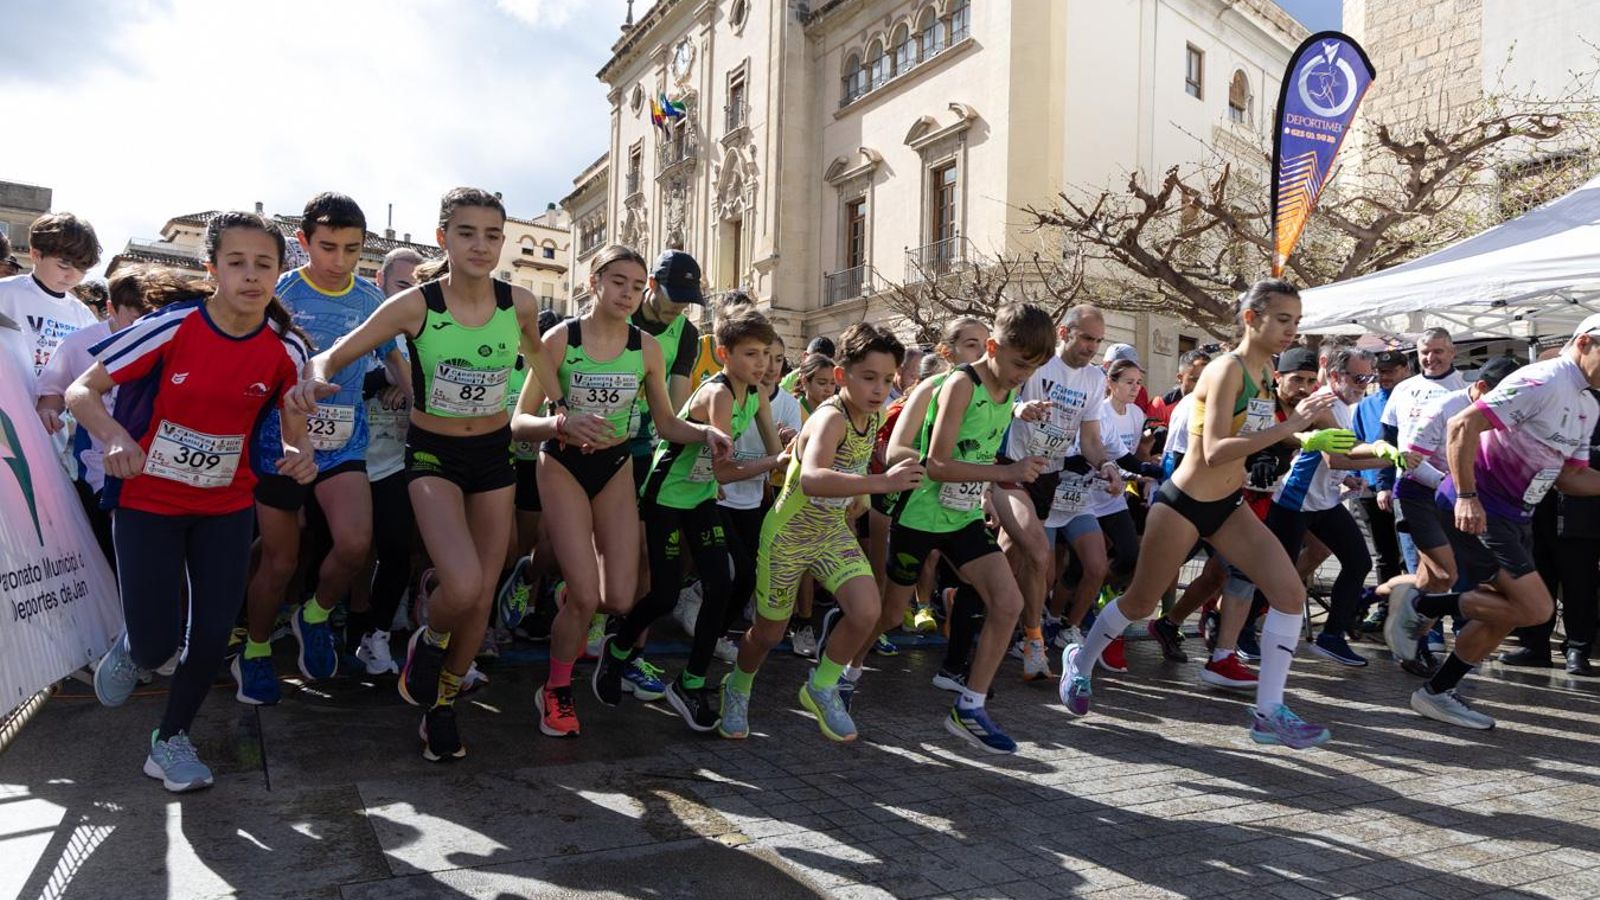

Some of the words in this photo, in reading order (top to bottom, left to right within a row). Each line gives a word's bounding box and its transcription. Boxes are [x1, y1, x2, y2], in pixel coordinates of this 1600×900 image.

[27, 315, 44, 333] V
[440, 366, 450, 376] V
[574, 373, 583, 384] V
[460, 385, 487, 401] 82
[587, 389, 620, 404] 336
[164, 423, 176, 435] V
[174, 447, 220, 470] 309
[959, 481, 982, 496] 523
